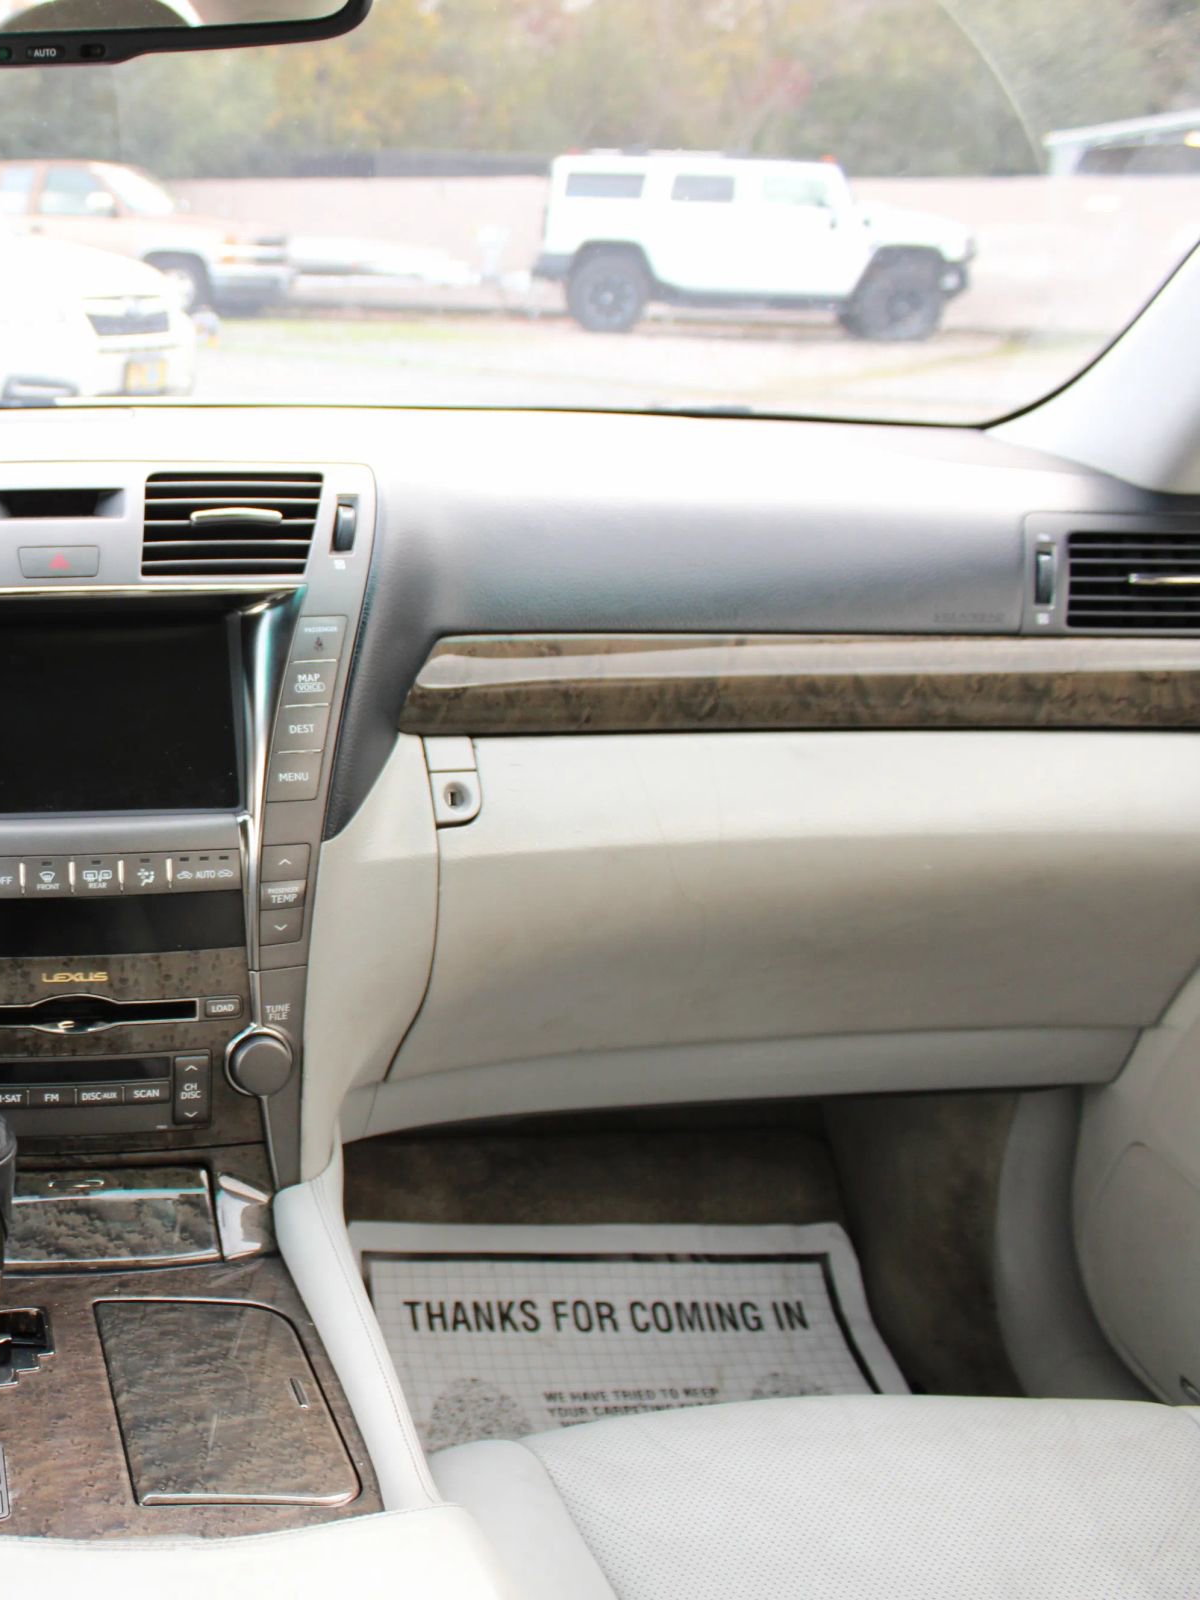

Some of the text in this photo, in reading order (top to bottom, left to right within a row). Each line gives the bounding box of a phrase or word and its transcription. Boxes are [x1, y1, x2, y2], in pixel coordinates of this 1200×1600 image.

[34, 48, 57, 57] AUTO
[297, 673, 320, 683] MAP
[289, 724, 314, 734] DEST
[279, 772, 309, 782] MENU
[195, 870, 216, 879] AUTO
[36, 883, 60, 891] FRONT
[88, 881, 108, 890] REAR
[271, 893, 298, 904] TEMP
[42, 972, 109, 983] LEXUS
[211, 1003, 235, 1013] LOAD
[265, 1003, 291, 1013] TUNE
[268, 1012, 289, 1022] FILE
[184, 1083, 197, 1092] CH
[44, 1093, 60, 1103] FM
[133, 1089, 160, 1099] SCAN
[180, 1091, 202, 1100] DISC
[403, 1299, 810, 1332] THANKS FOR COMING IN
[543, 1391, 566, 1403] WE
[569, 1390, 607, 1402] HAVE
[612, 1389, 657, 1401] TRIED
[660, 1388, 680, 1400] TO
[547, 1406, 590, 1419] YOUR
